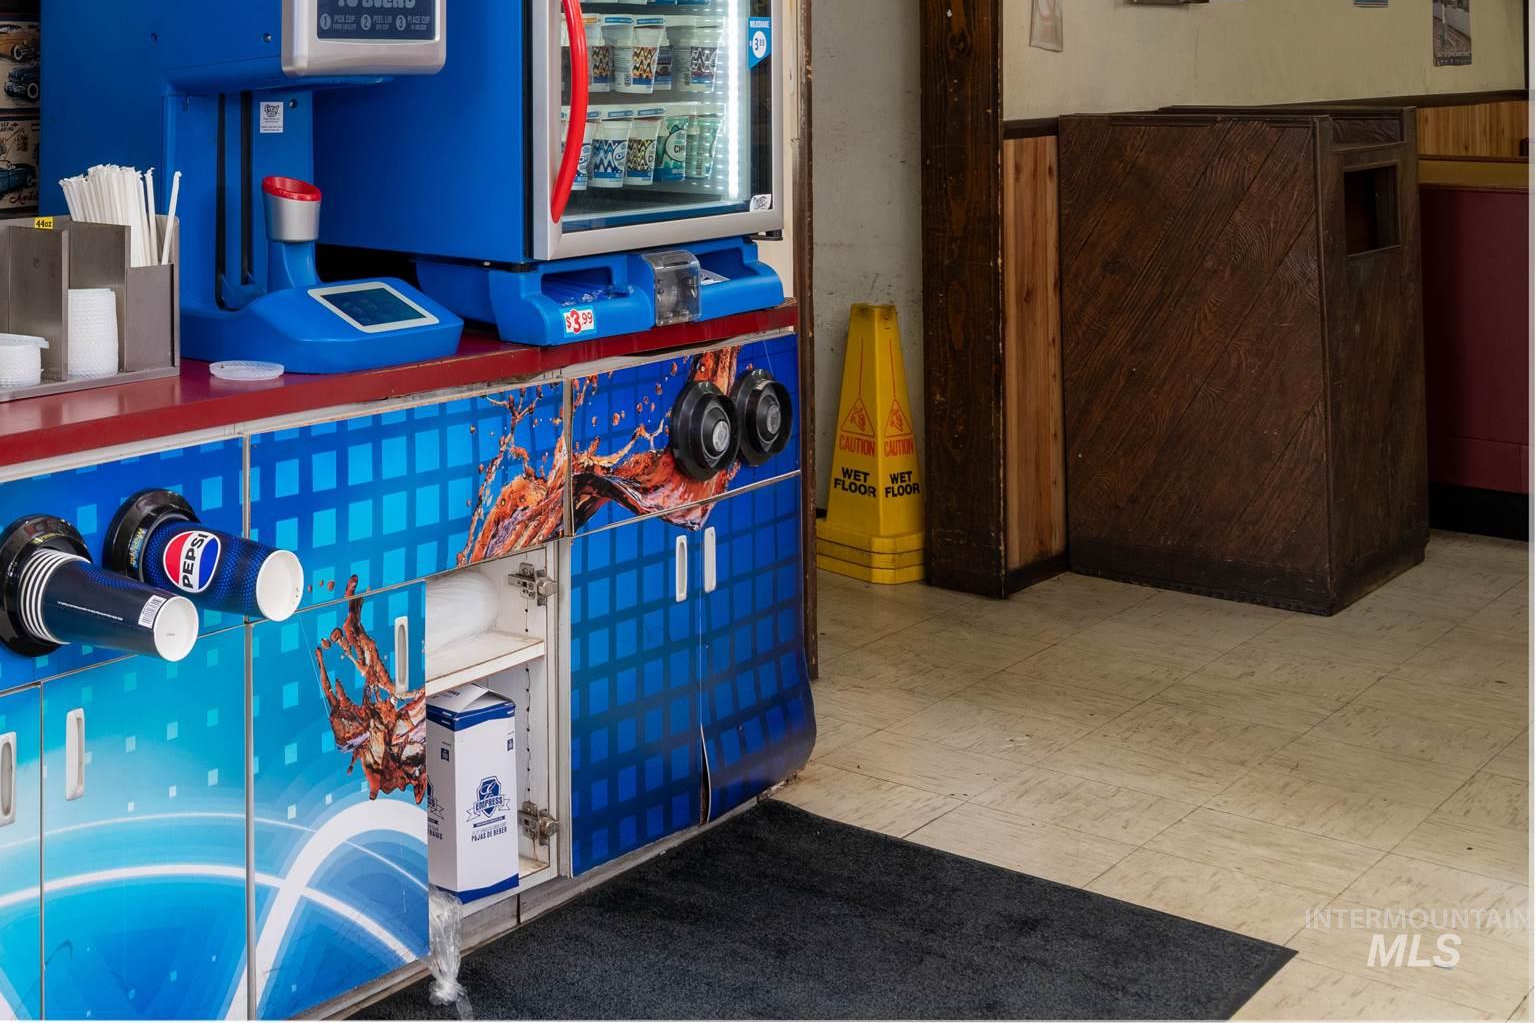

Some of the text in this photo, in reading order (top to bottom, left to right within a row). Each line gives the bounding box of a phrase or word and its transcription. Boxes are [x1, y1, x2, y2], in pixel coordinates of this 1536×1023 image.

[36, 220, 52, 228] 44oz
[566, 310, 593, 333] $3.99
[839, 434, 875, 456] CAUTION
[884, 437, 914, 457] CAUTION
[841, 466, 870, 484] WET
[889, 470, 913, 484] WET
[834, 477, 877, 498] FLOOR
[885, 482, 920, 498] FLOOR
[182, 532, 208, 588] PEPSI
[476, 796, 503, 811] EMPRESS
[471, 832, 486, 842] PAJAS
